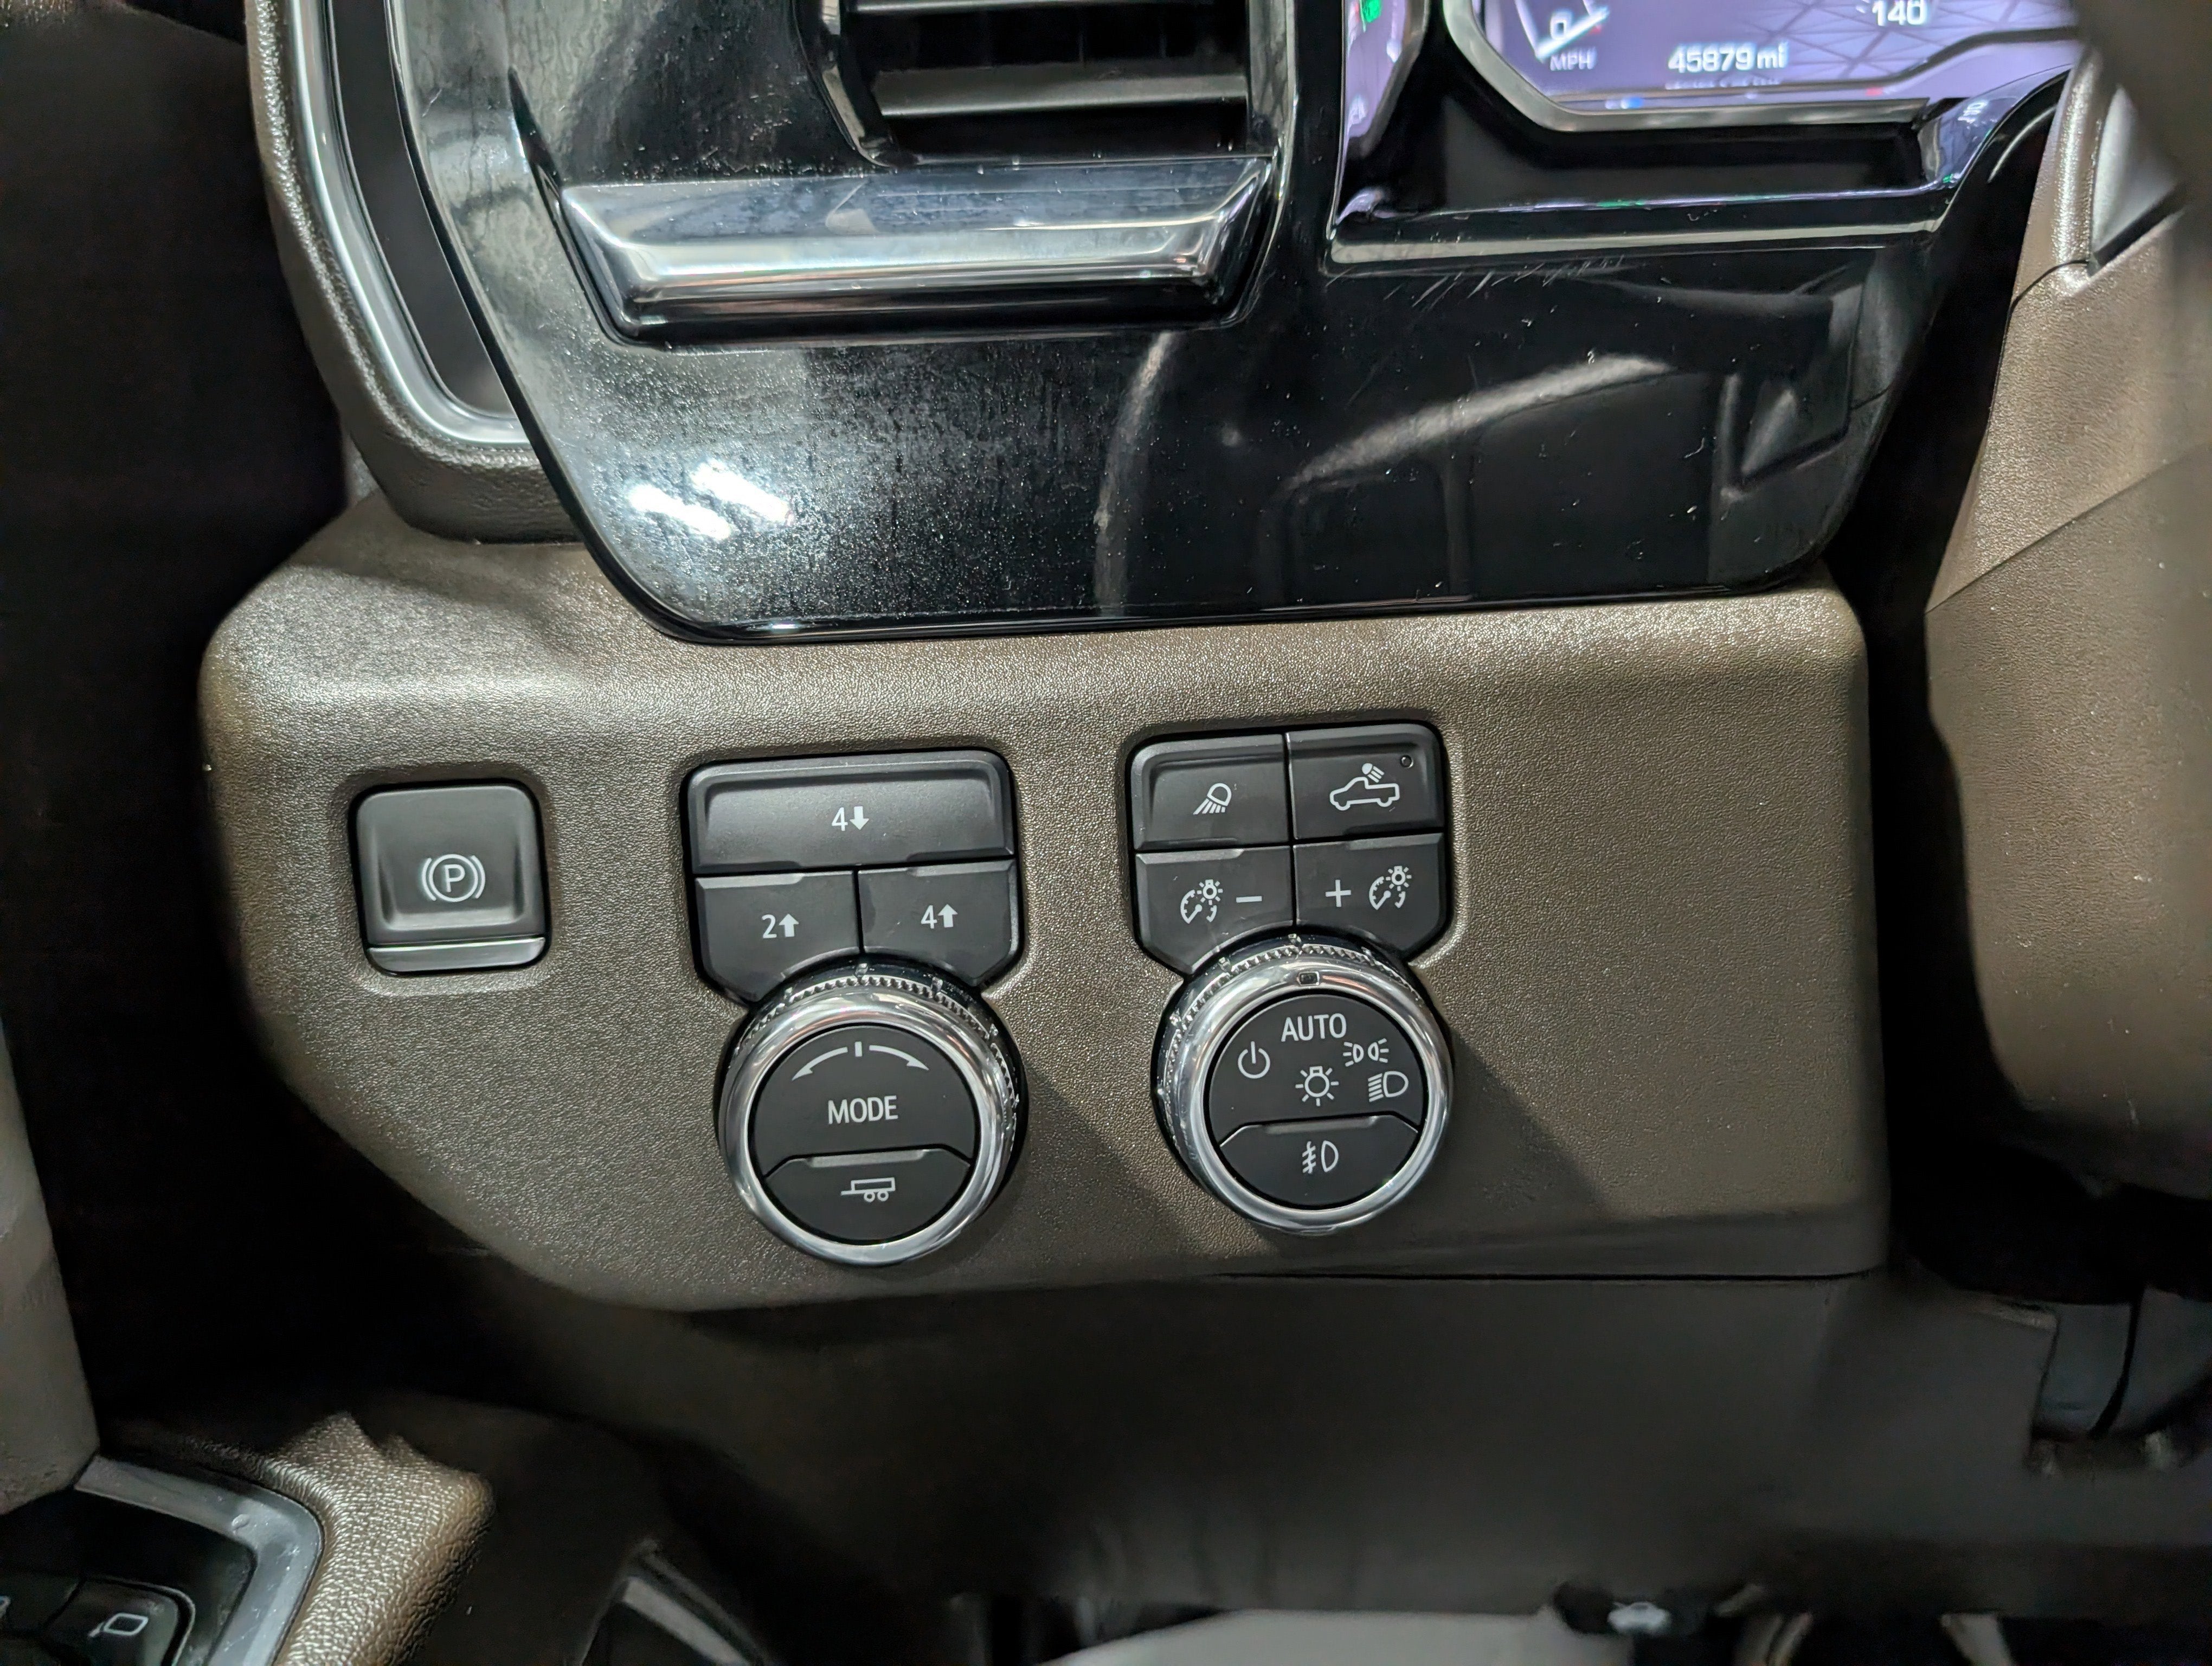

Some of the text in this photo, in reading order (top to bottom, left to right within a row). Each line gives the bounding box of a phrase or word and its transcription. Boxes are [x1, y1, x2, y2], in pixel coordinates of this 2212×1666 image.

[1549, 47, 1597, 71] MPH
[1668, 40, 1789, 73] 45879 mi
[444, 864, 466, 893] P
[1281, 1013, 1347, 1042] AUTO
[827, 1095, 899, 1125] MODE
